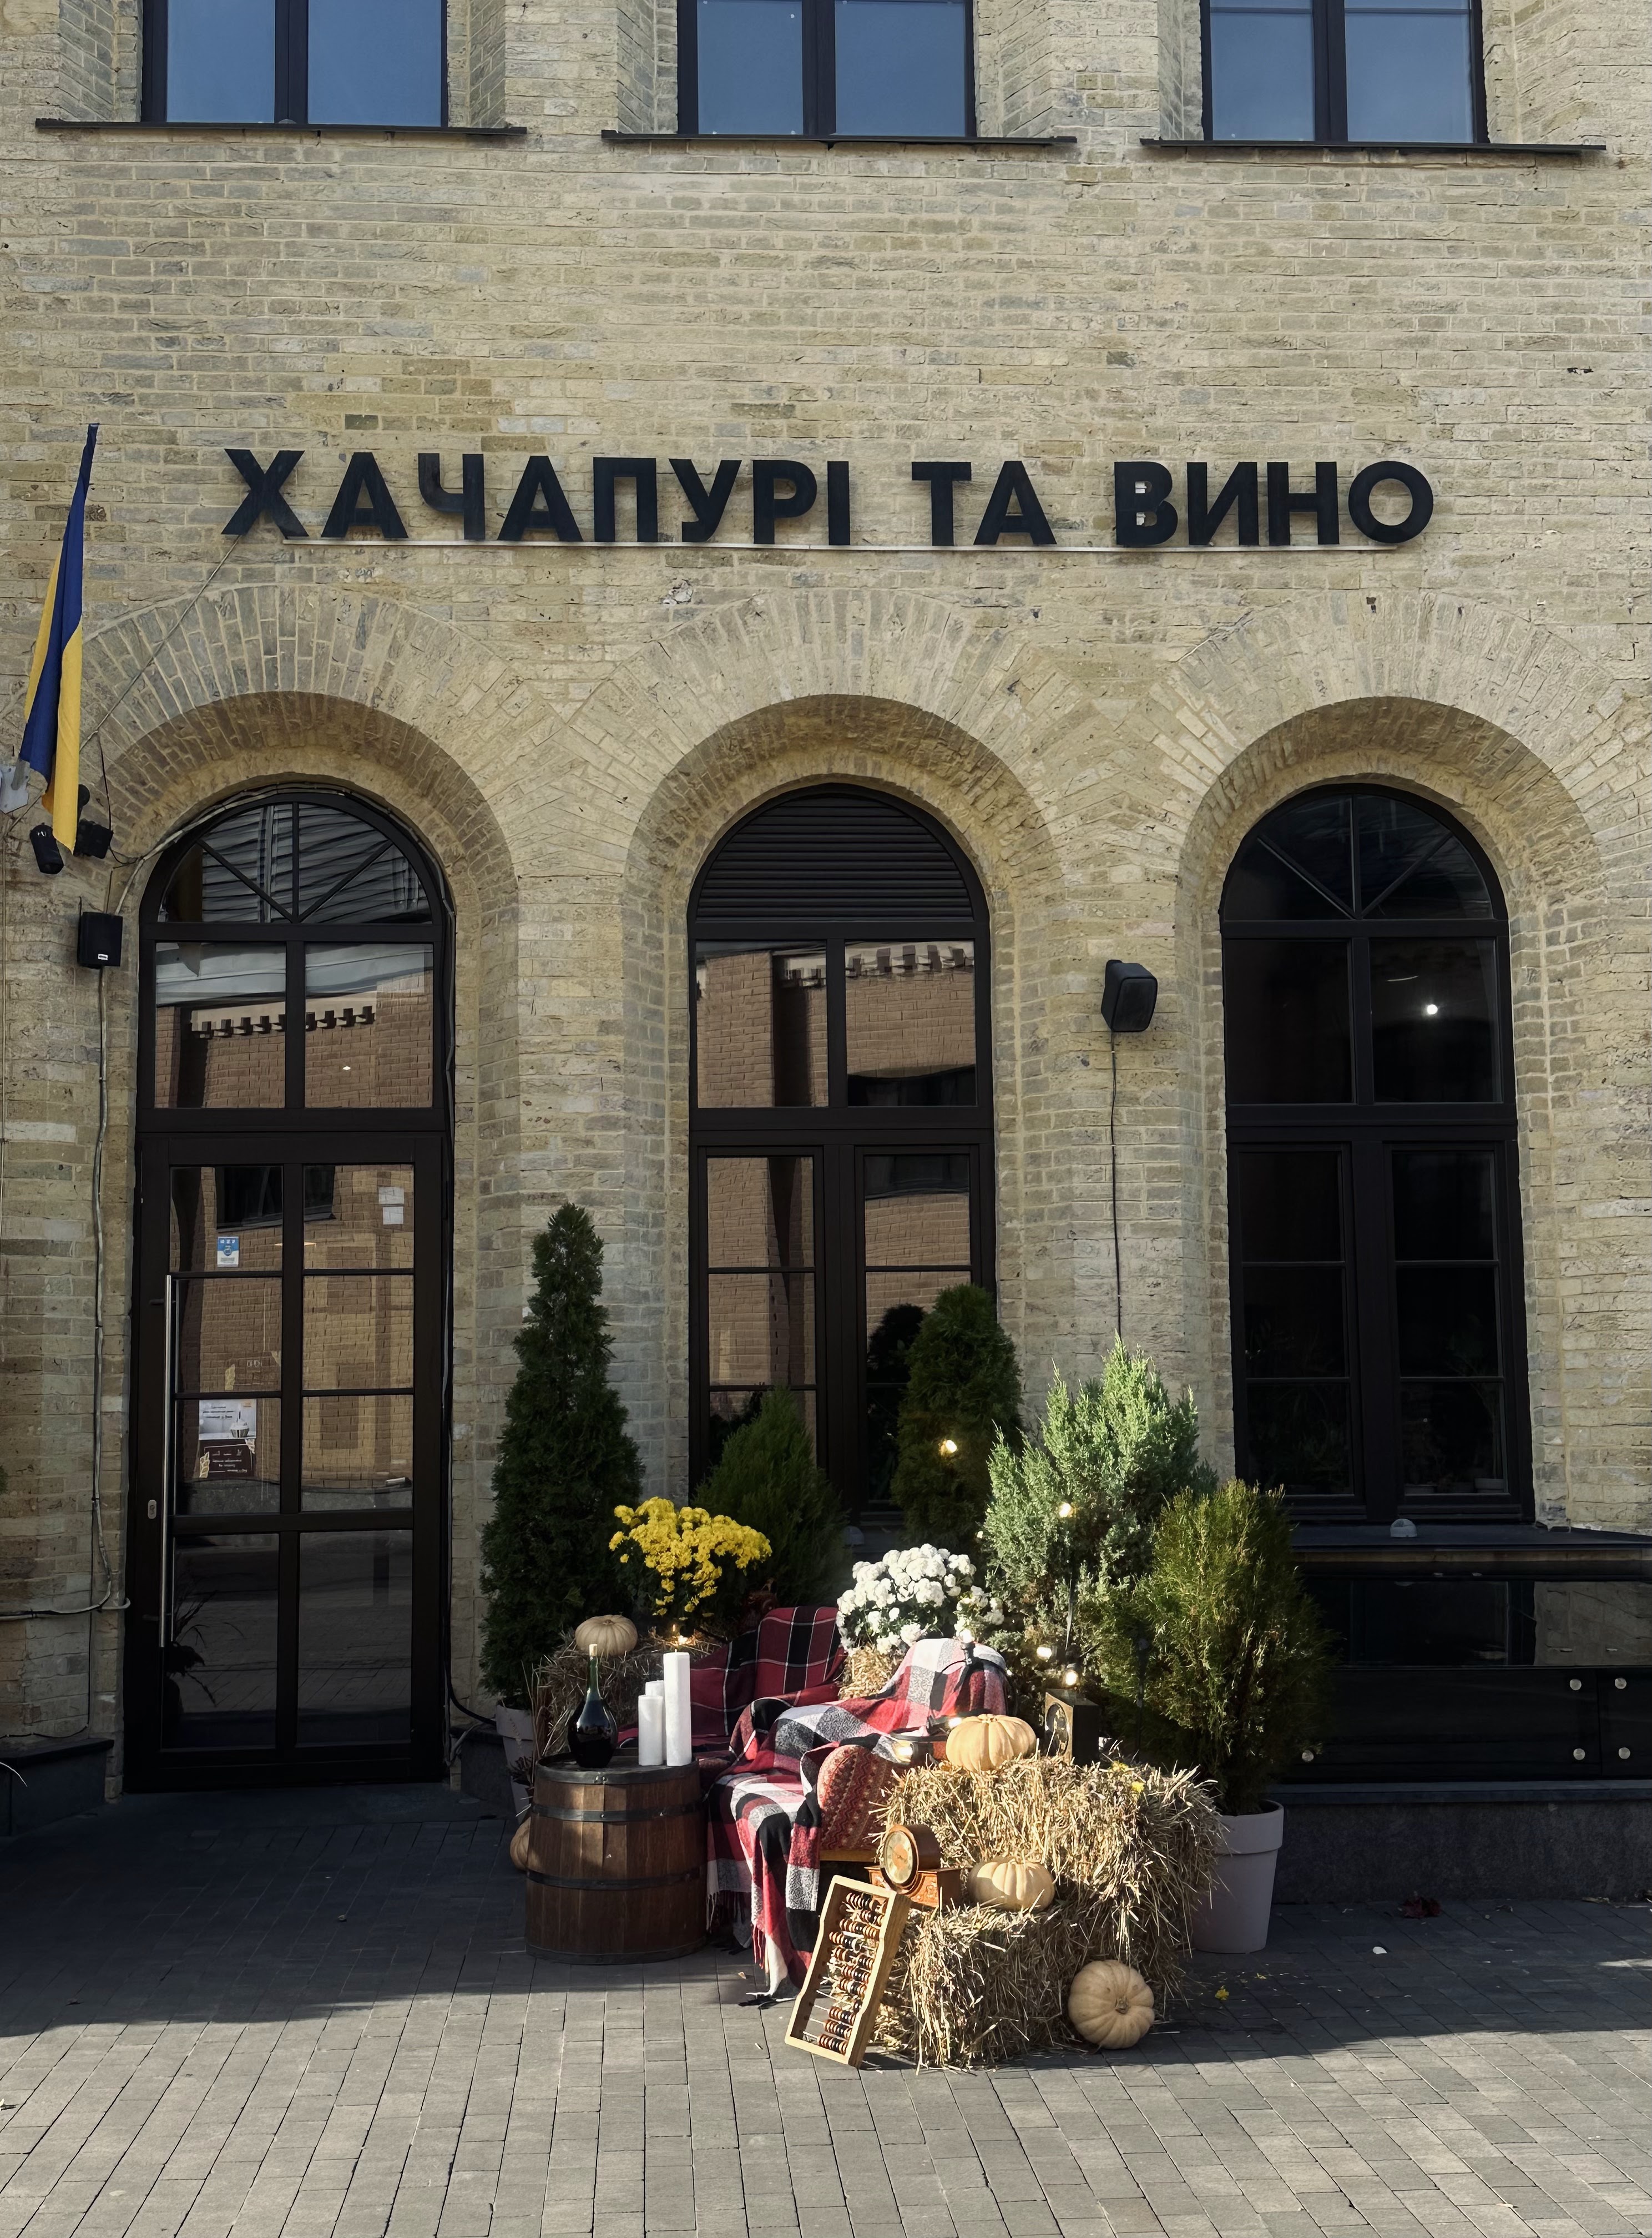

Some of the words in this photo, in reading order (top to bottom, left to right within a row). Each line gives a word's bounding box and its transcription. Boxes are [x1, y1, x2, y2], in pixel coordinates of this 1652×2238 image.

[221, 448, 851, 545] ХАЧАПУРІ
[912, 461, 1057, 546] ТА
[1113, 461, 1433, 546] ВИНО
